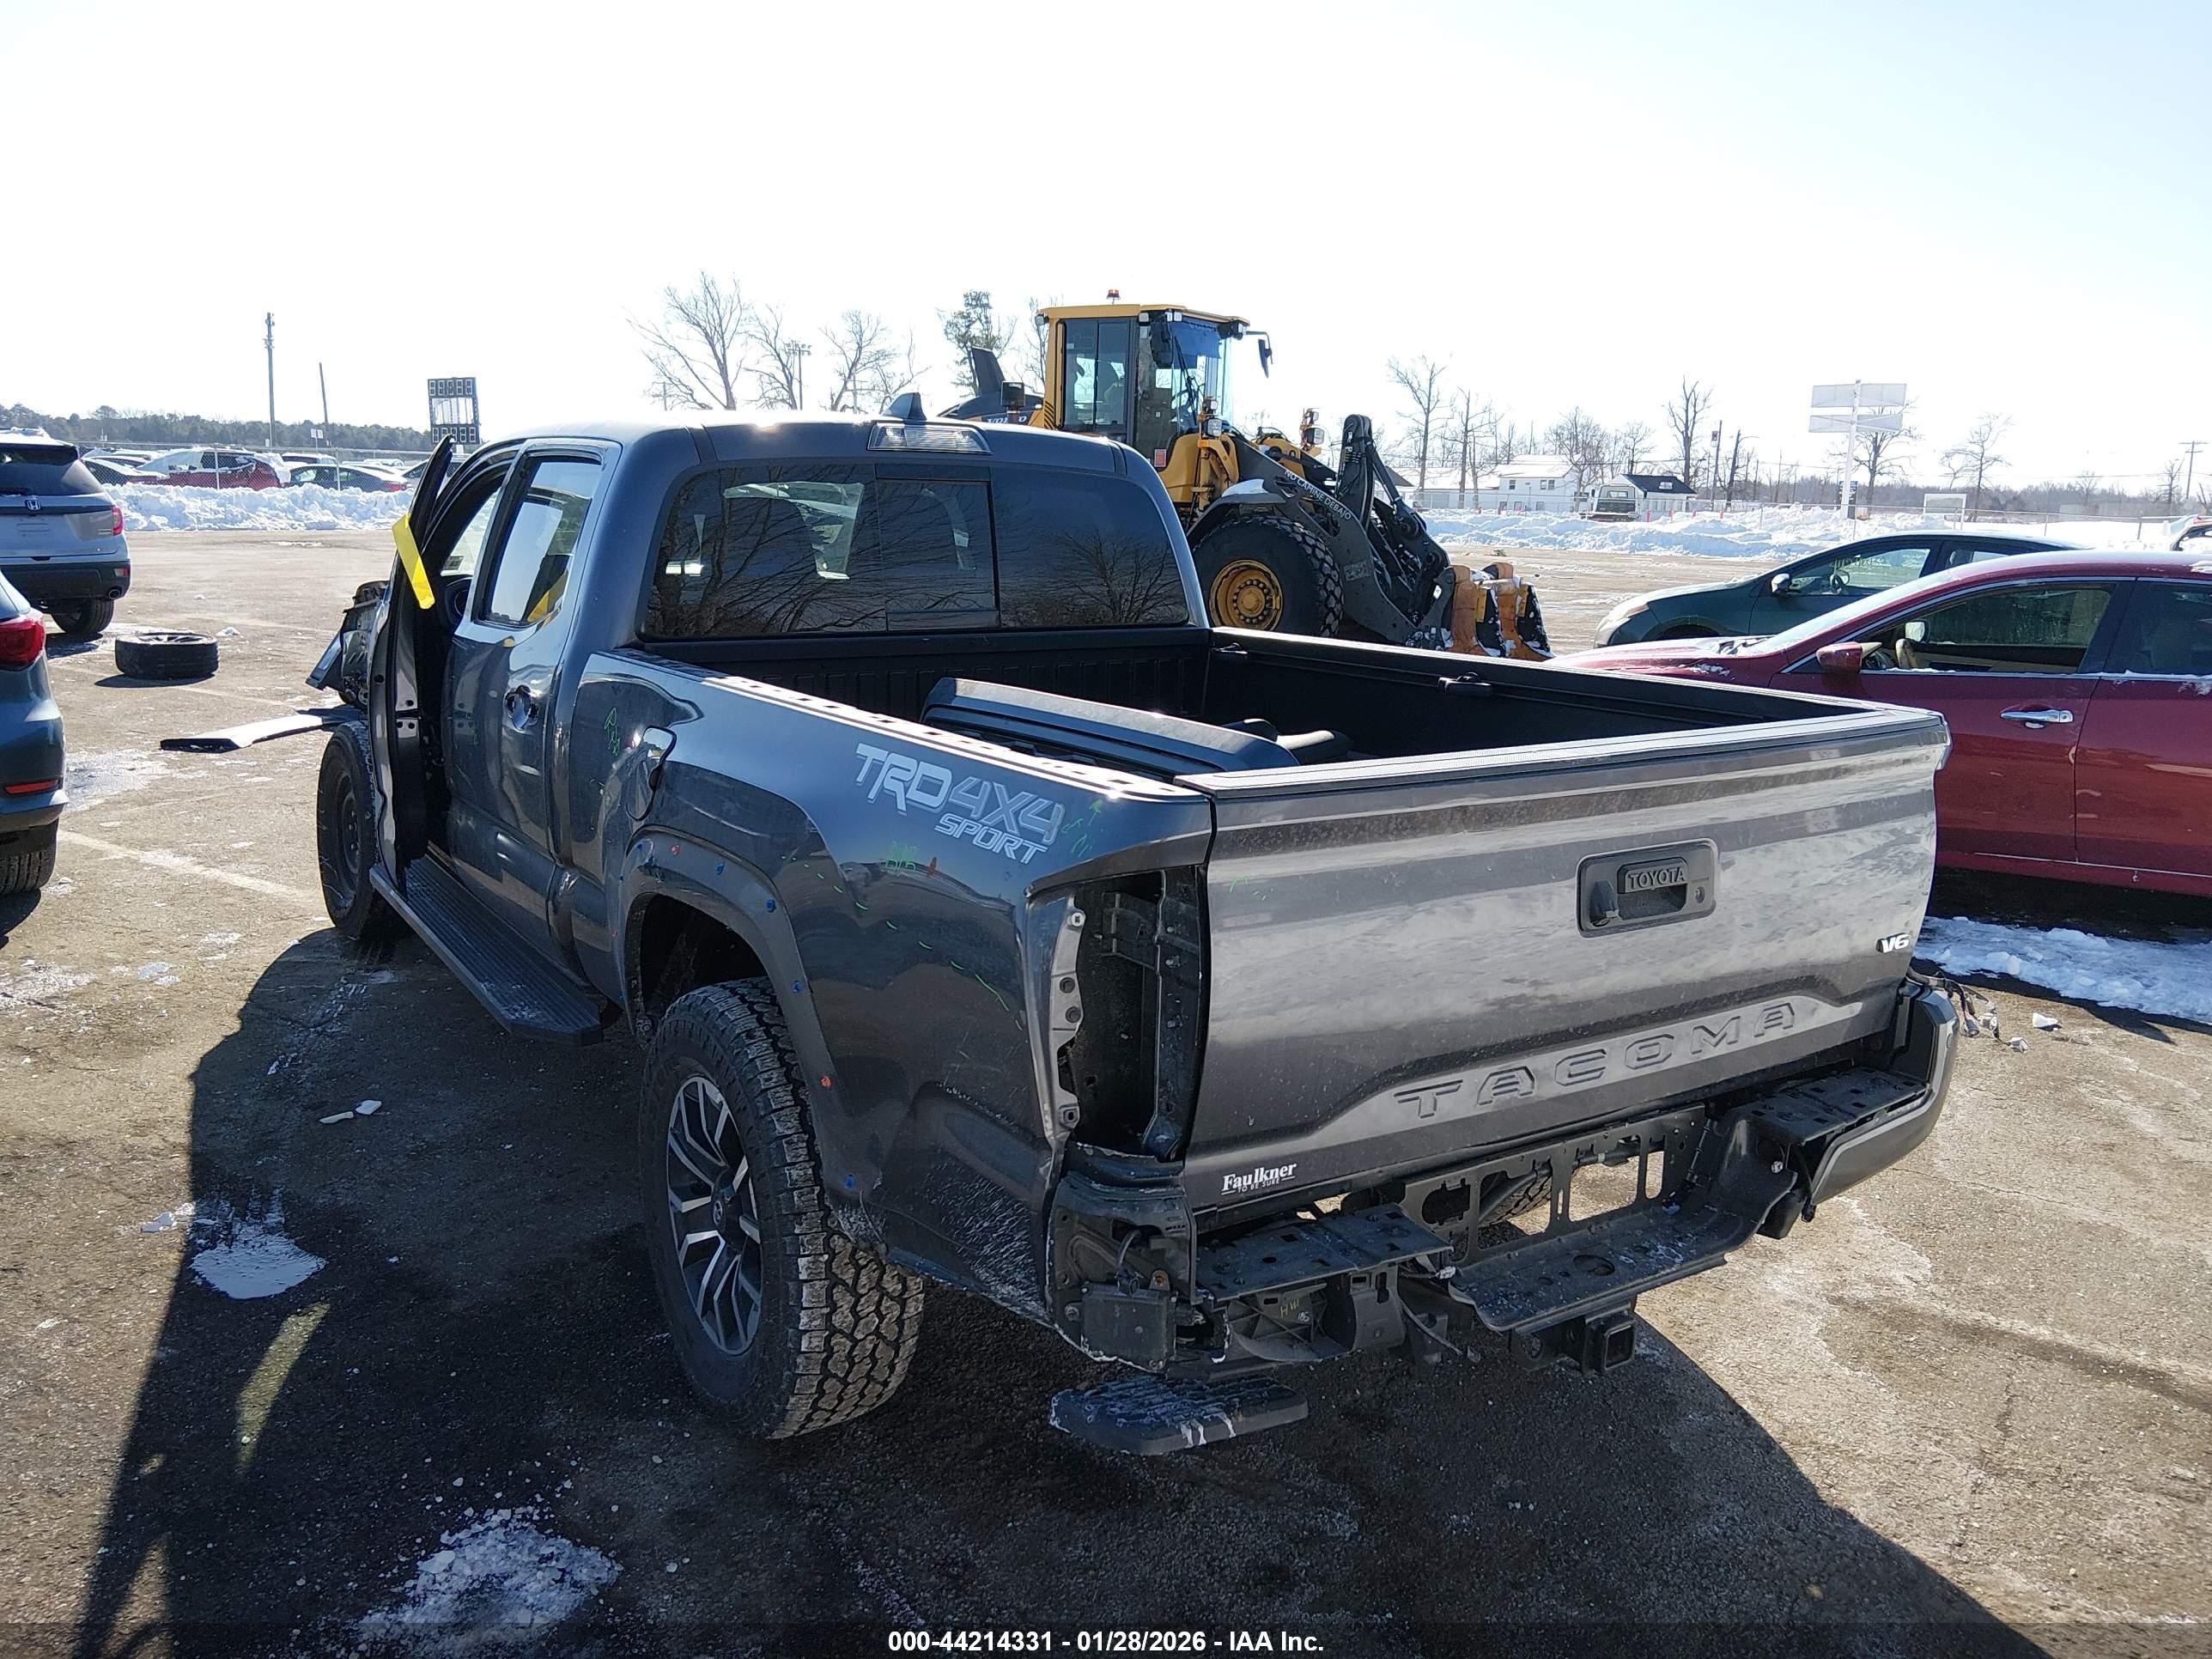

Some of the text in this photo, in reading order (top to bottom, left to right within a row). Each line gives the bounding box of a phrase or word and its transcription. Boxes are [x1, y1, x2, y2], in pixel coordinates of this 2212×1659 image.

[1284, 470, 1352, 520] NO CAMINE DEBAJO
[855, 743, 952, 815] TRD
[947, 776, 1065, 844] 4X4
[933, 813, 1048, 865] SPORT
[1628, 866, 1686, 890] TOYOTA
[1881, 933, 1911, 953] V6
[1393, 1002, 1796, 1119] TACOMA
[1221, 1163, 1297, 1193] Faulkner
[1262, 1177, 1280, 1188] SURE
